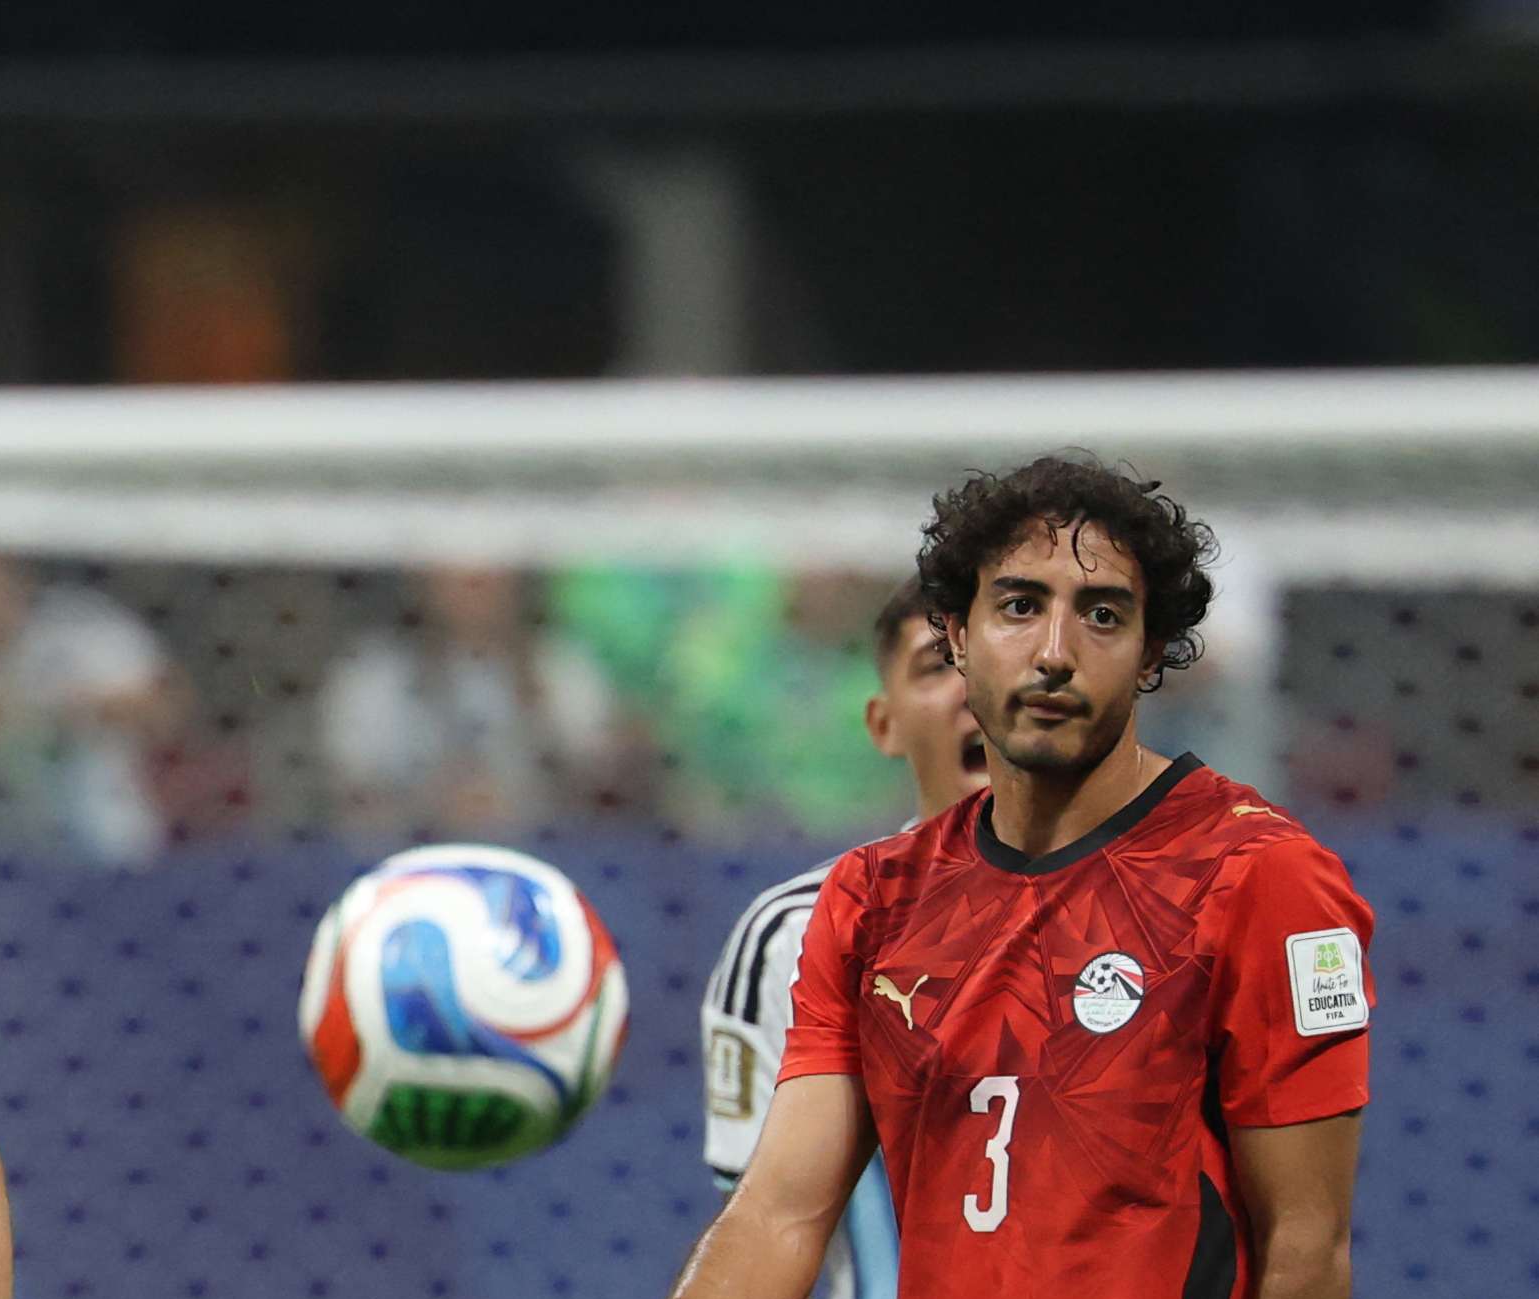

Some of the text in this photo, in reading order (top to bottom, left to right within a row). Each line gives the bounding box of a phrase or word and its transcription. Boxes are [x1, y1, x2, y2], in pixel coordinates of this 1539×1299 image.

[1308, 993, 1358, 1012] EDUCATION
[1326, 1010, 1345, 1020] FIFA
[963, 1075, 1020, 1232] 3
